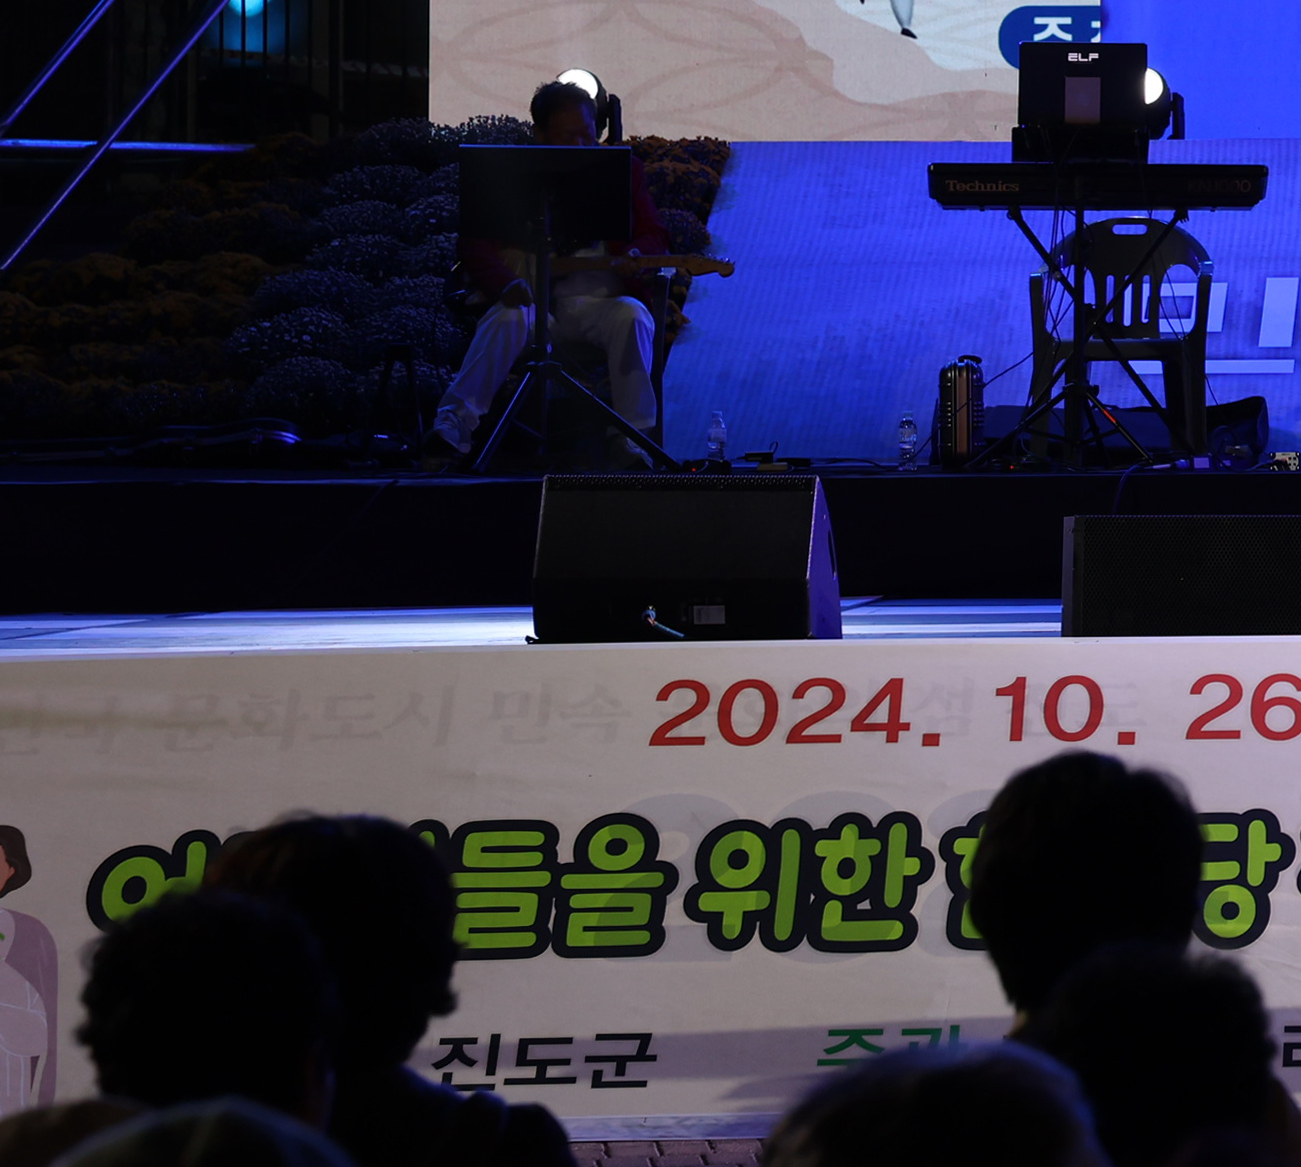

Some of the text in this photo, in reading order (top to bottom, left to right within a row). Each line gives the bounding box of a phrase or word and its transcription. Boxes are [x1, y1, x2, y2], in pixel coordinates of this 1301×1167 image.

[1067, 52, 1100, 63] ELF
[945, 179, 1021, 193] Technics
[648, 676, 942, 748] 2024.
[995, 674, 1138, 747] 10.
[684, 810, 935, 953] 위한
[430, 1032, 659, 1091] 진도군
